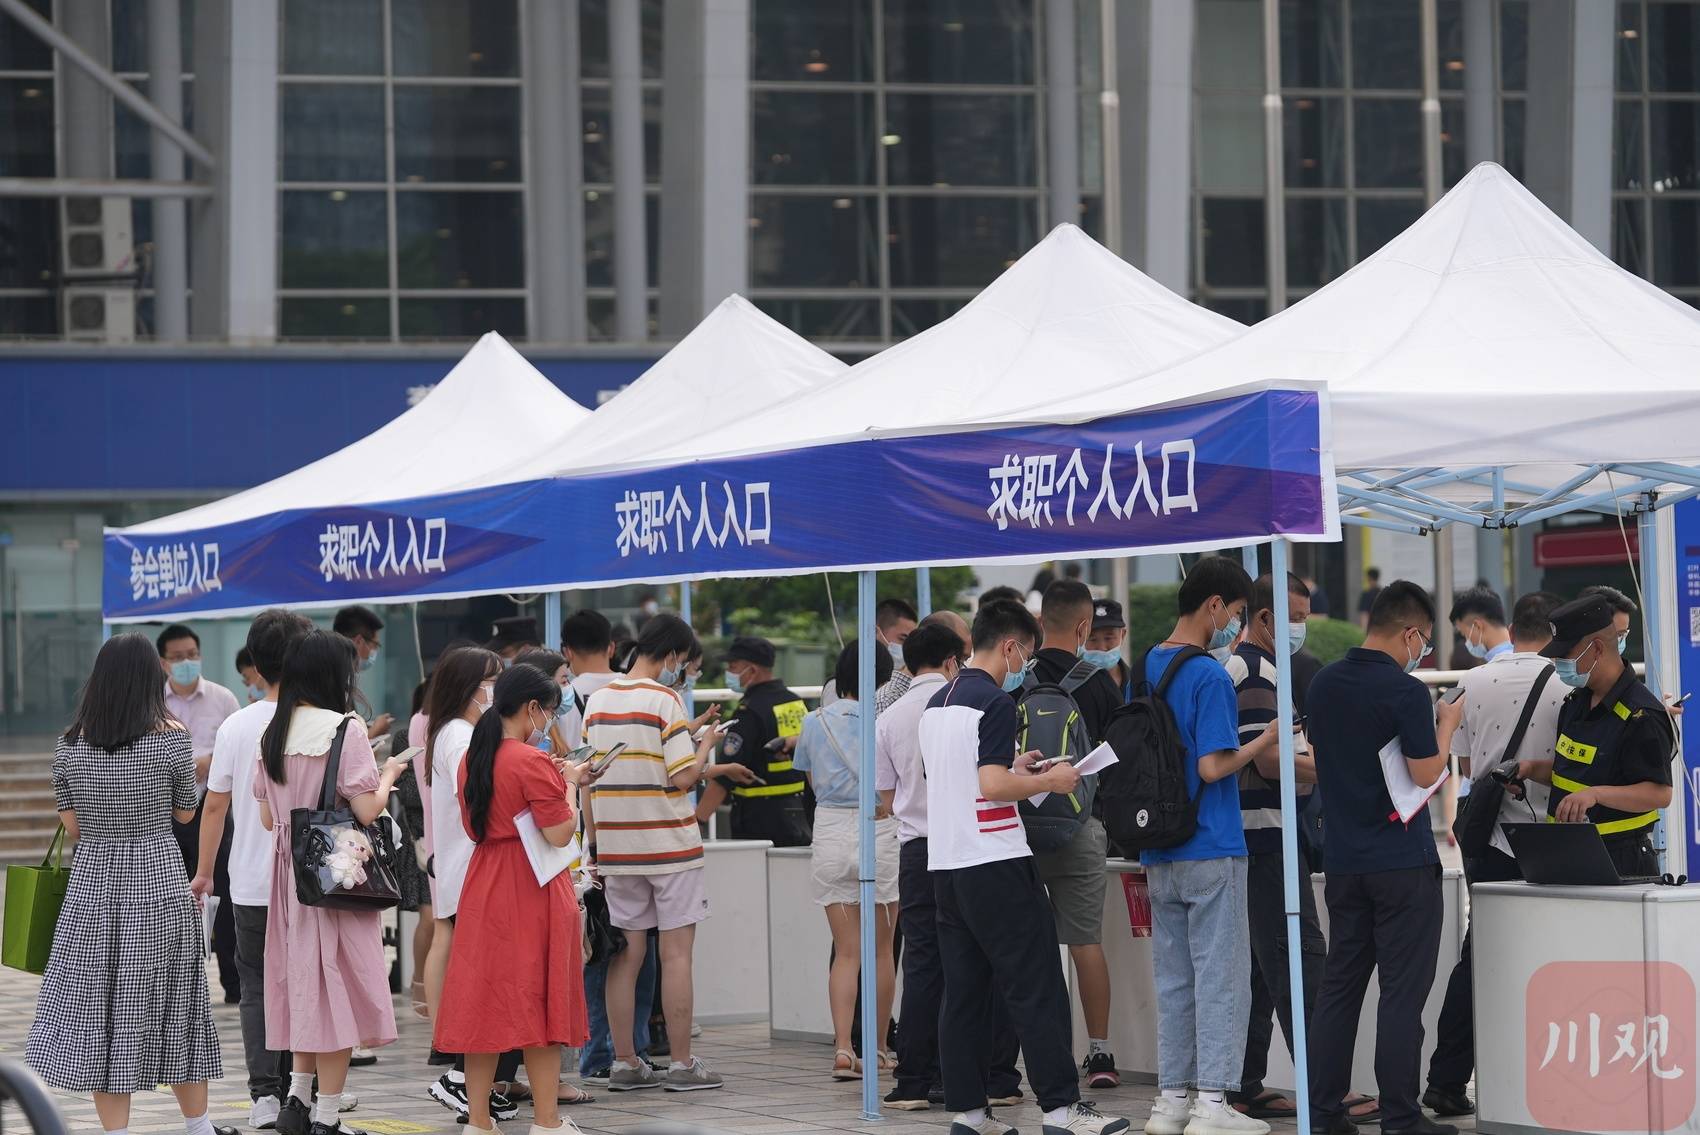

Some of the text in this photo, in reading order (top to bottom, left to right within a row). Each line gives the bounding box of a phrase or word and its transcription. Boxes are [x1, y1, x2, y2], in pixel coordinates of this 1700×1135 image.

[615, 480, 771, 557] 求职个人入口
[987, 439, 1198, 531] 求职个人入口
[130, 542, 222, 601] 参会单位入口
[319, 517, 446, 582] 求职个人入口
